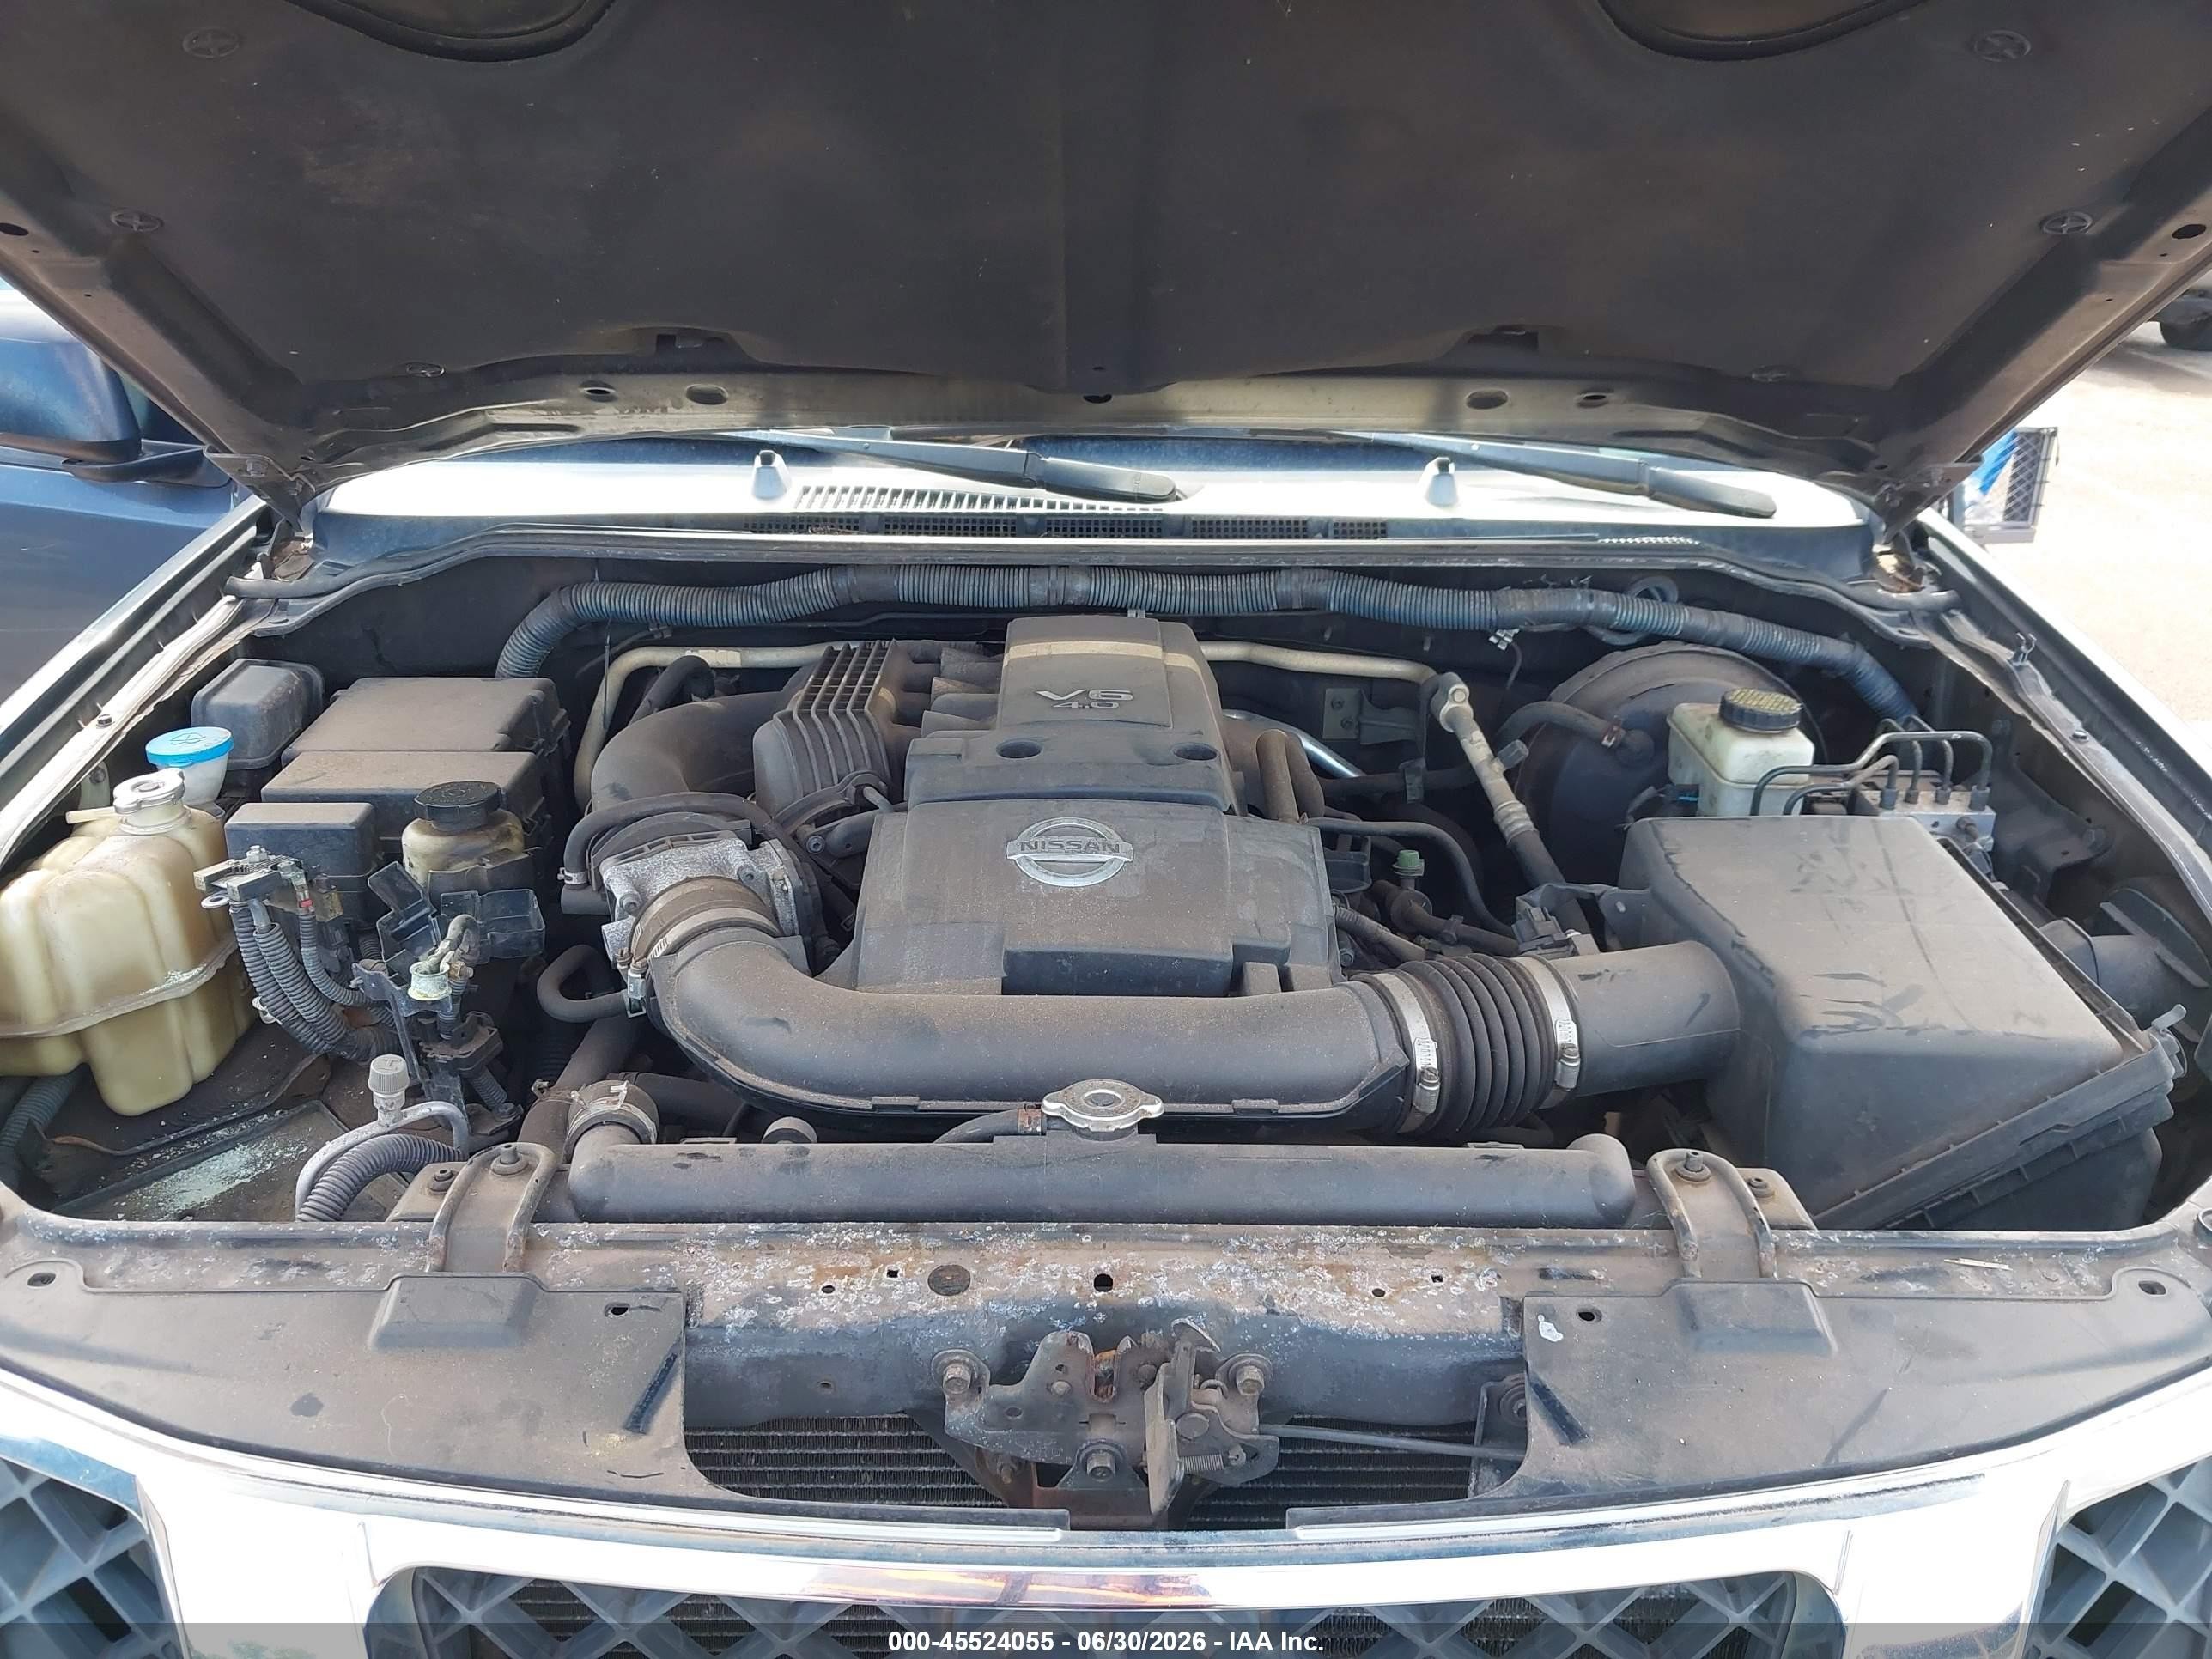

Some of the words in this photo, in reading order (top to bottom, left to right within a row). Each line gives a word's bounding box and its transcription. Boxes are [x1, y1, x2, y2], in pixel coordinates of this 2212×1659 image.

[1036, 689, 1133, 701] V6
[1053, 701, 1120, 709] 4.0
[1019, 839, 1120, 854] NISSAN
